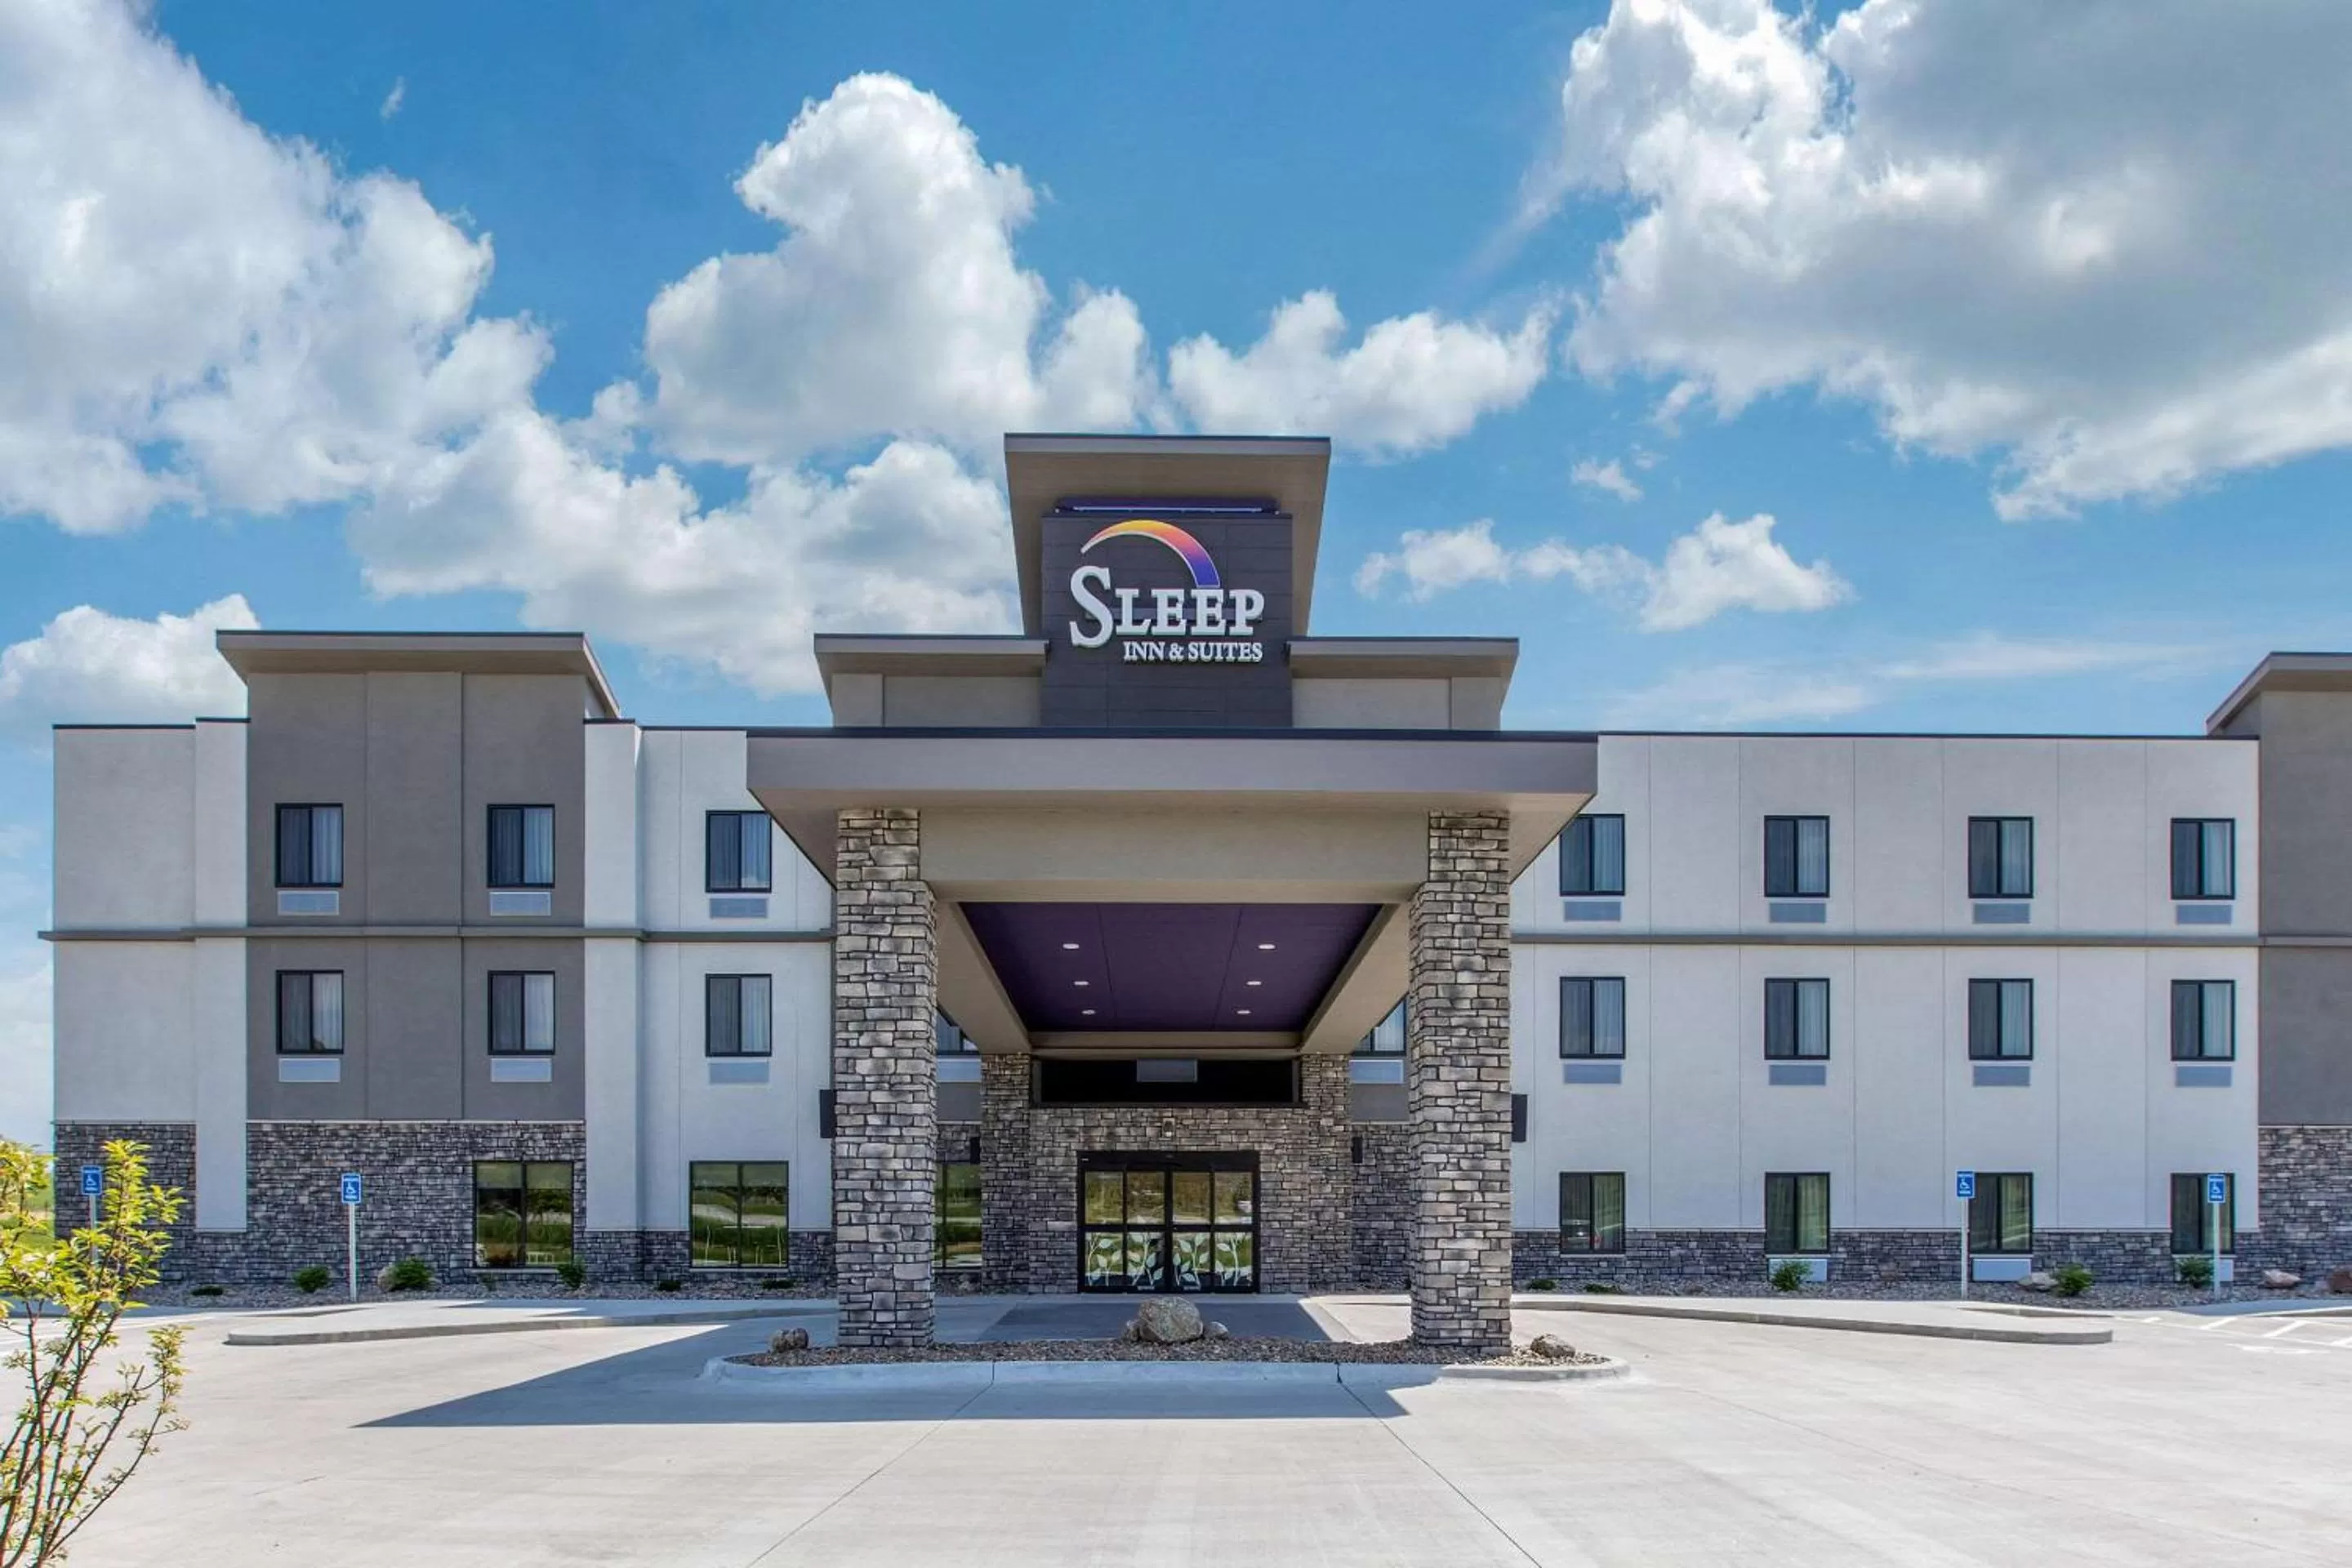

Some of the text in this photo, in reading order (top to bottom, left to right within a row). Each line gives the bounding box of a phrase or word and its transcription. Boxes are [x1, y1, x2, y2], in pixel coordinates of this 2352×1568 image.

[1069, 565, 1265, 648] SLEEP
[1123, 641, 1263, 662] INN & SUITES
